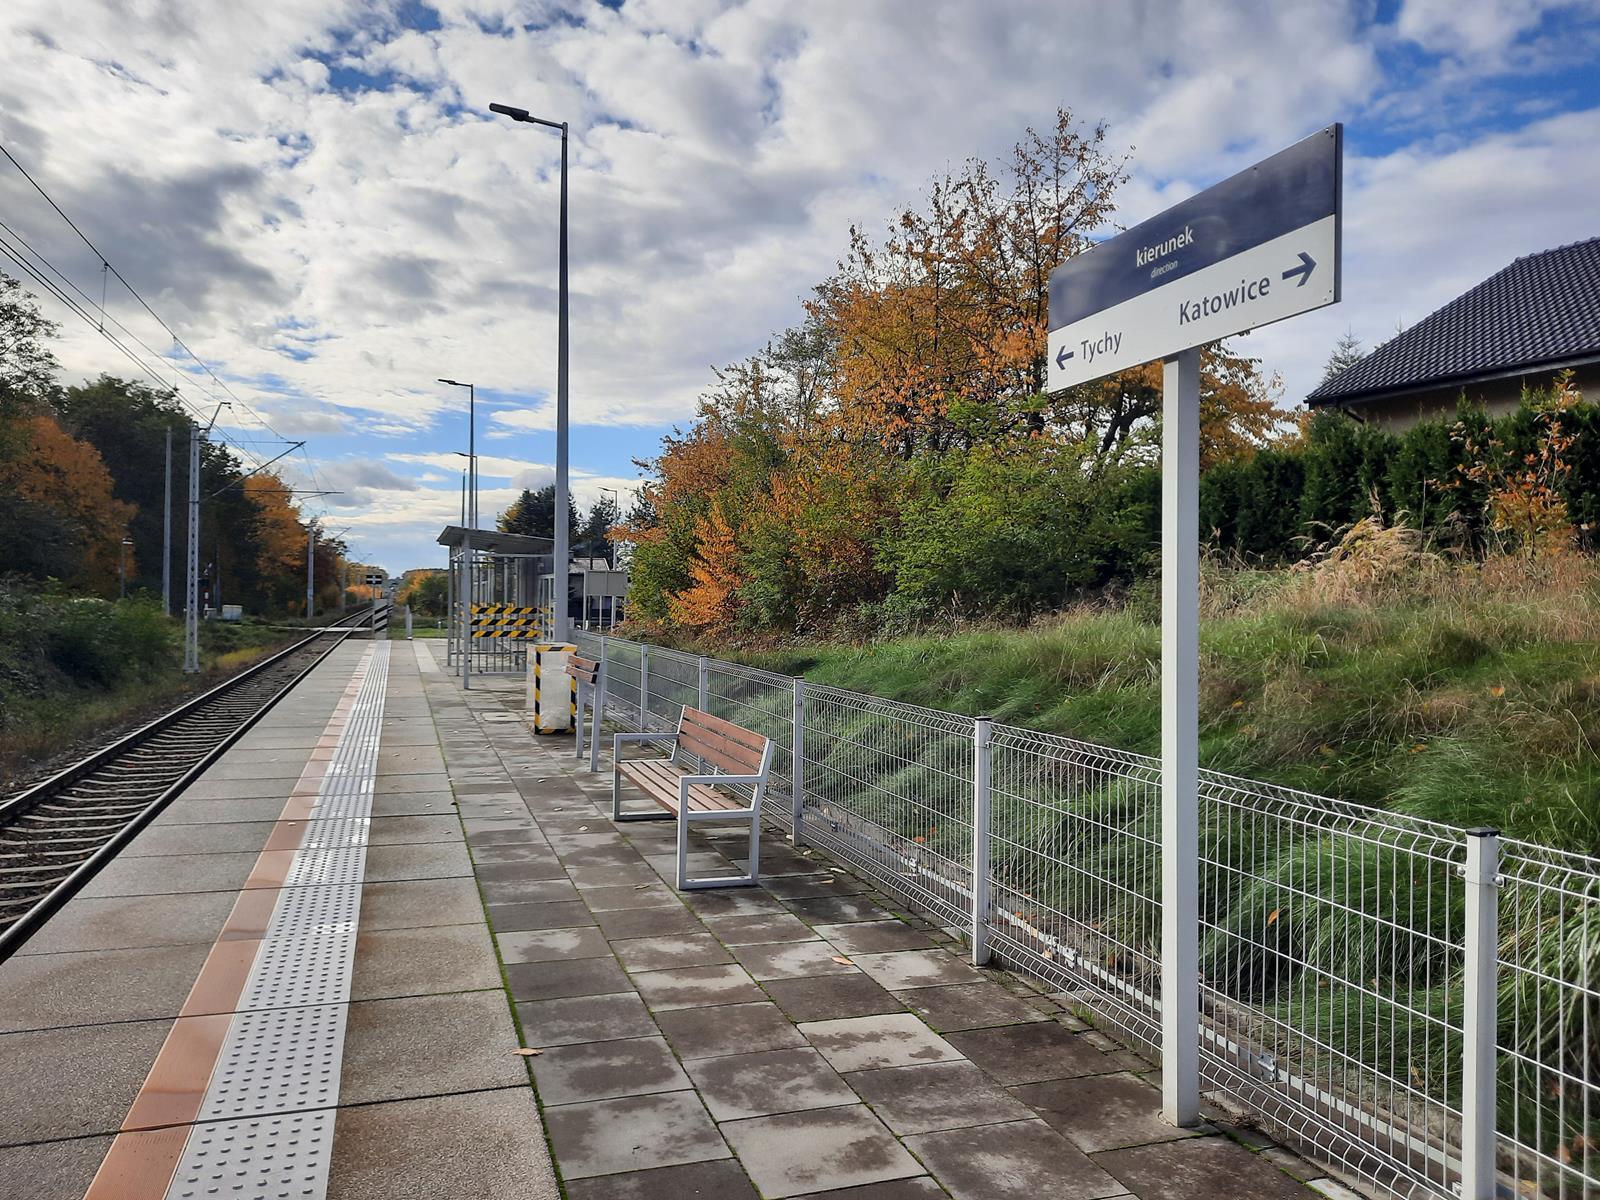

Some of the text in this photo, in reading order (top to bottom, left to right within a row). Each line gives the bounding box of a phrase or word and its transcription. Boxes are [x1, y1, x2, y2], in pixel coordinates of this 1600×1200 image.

[1136, 225, 1194, 268] kierunek
[1150, 259, 1178, 279] direction
[1179, 275, 1271, 326] Katowice
[1081, 331, 1122, 364] Tychy
